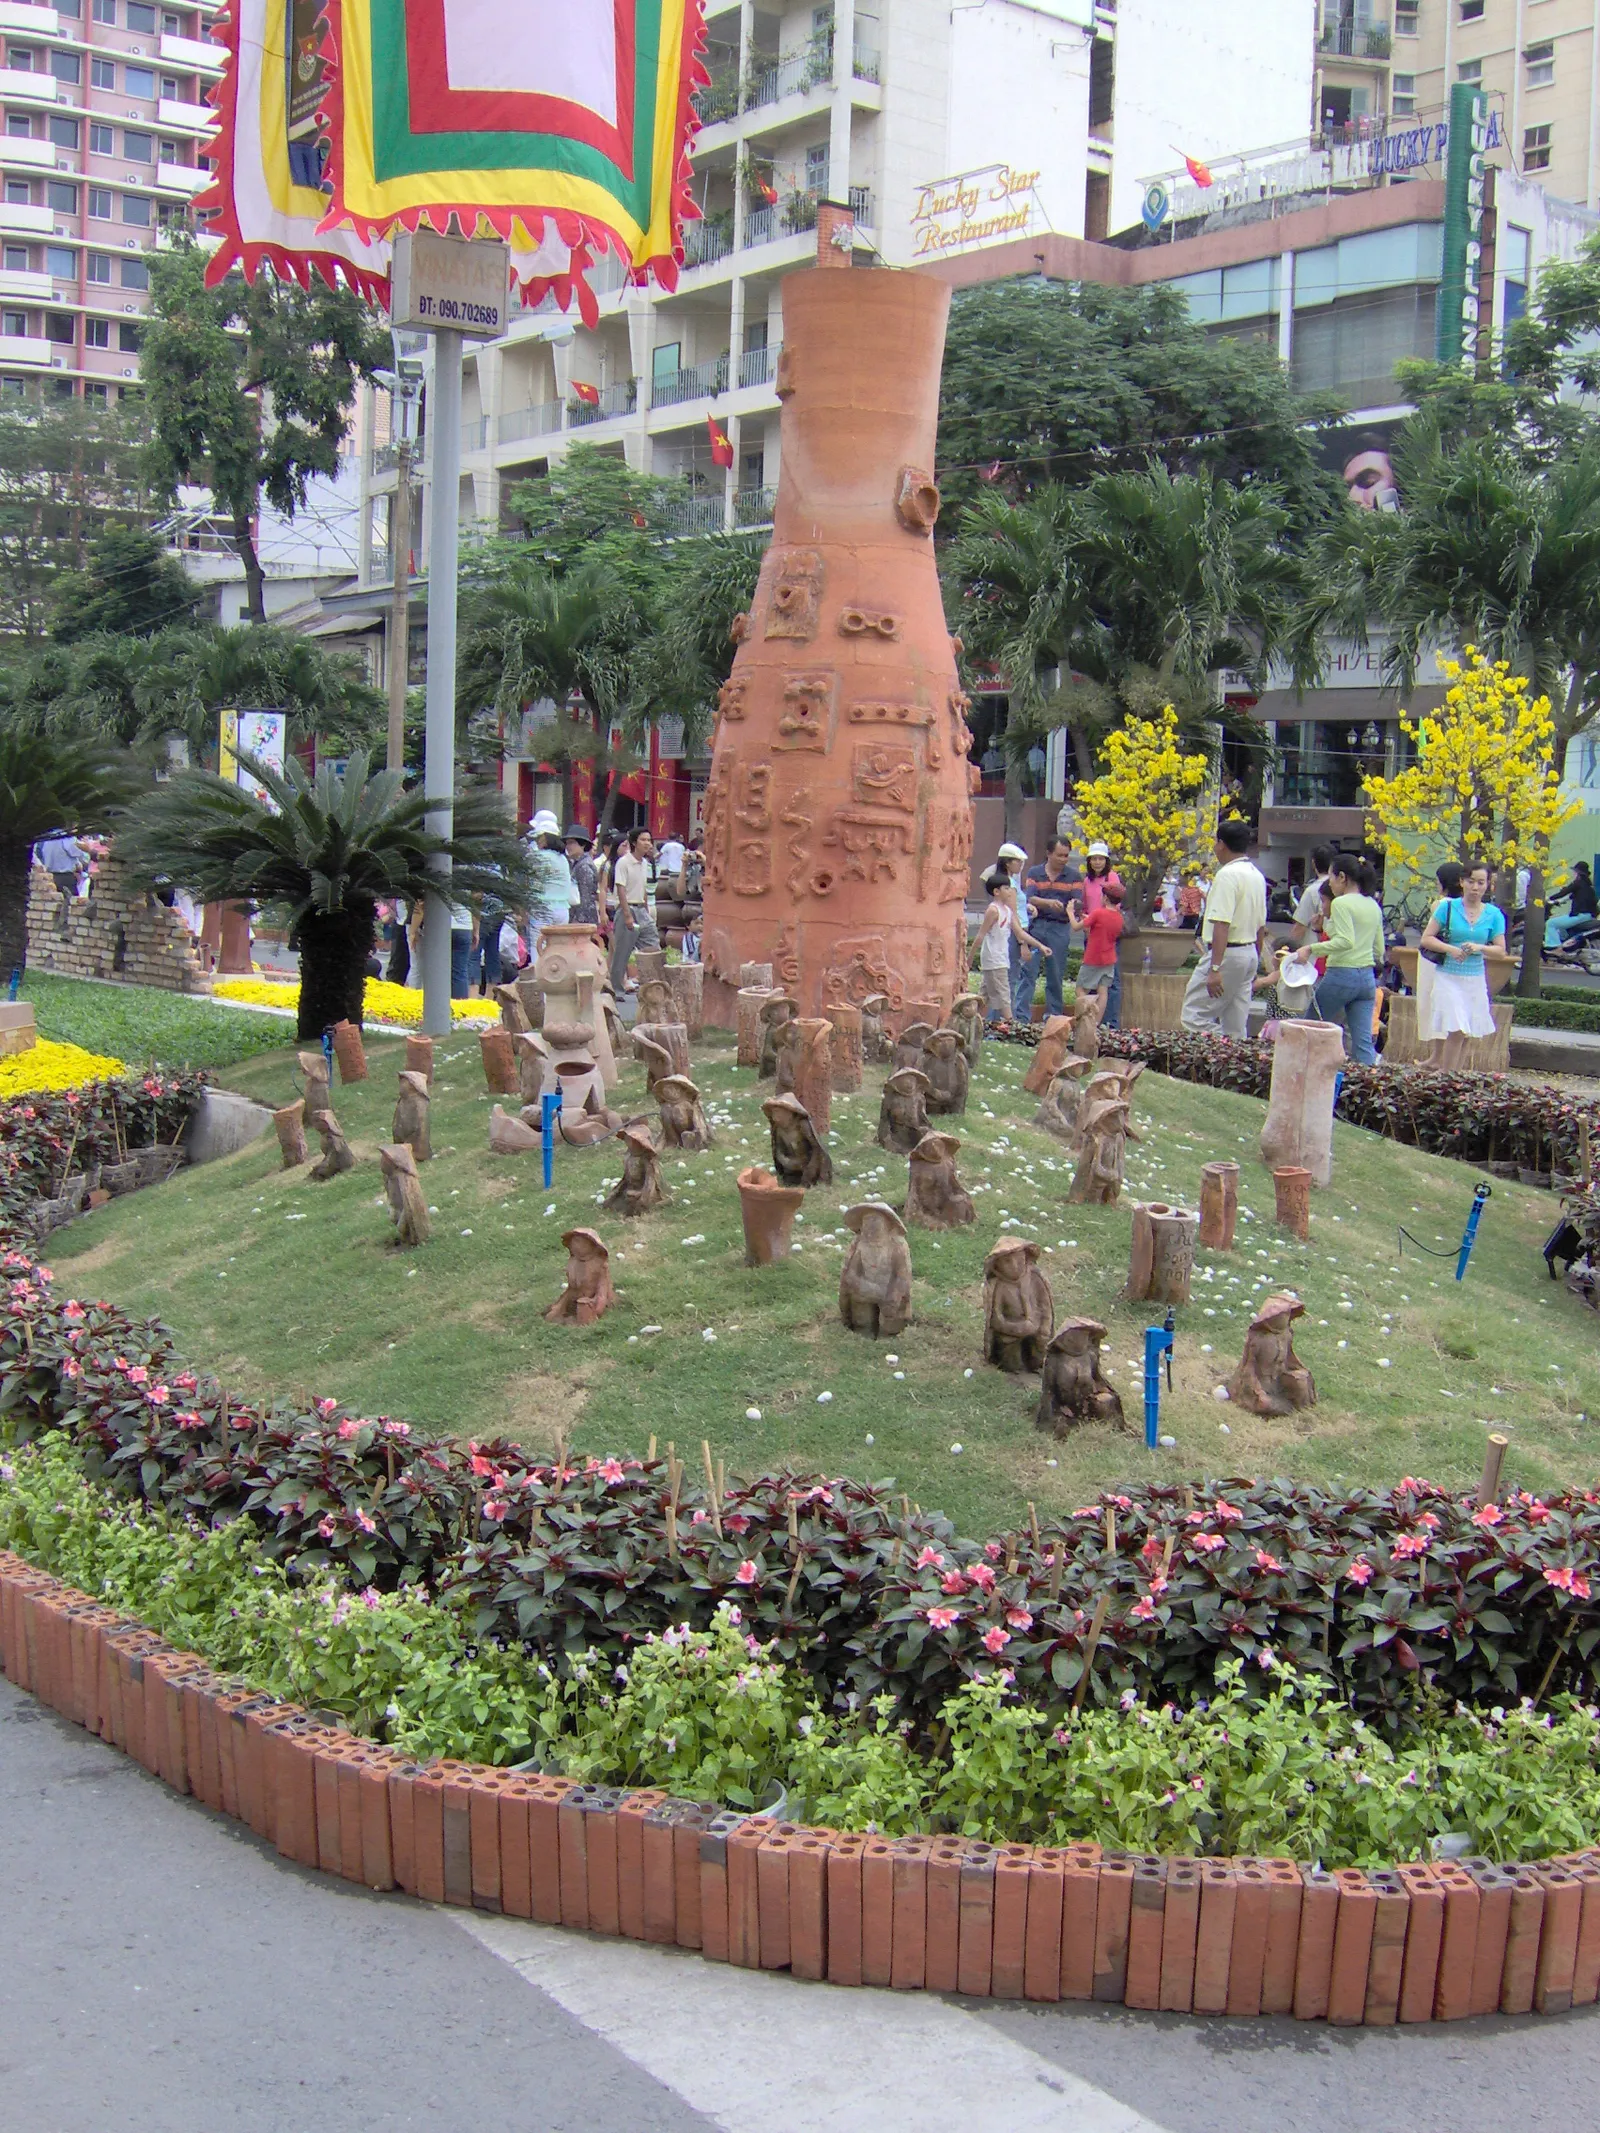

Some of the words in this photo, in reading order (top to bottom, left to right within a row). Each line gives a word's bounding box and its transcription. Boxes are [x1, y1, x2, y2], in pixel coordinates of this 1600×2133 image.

[1371, 126, 1434, 175] LUCKY
[1467, 96, 1486, 232] LUCKY
[910, 179, 979, 224] Lucky
[990, 168, 1040, 201] Star
[913, 203, 1029, 256] Restaurant
[420, 295, 436, 315] ĐT:
[440, 300, 497, 325] 090.702689
